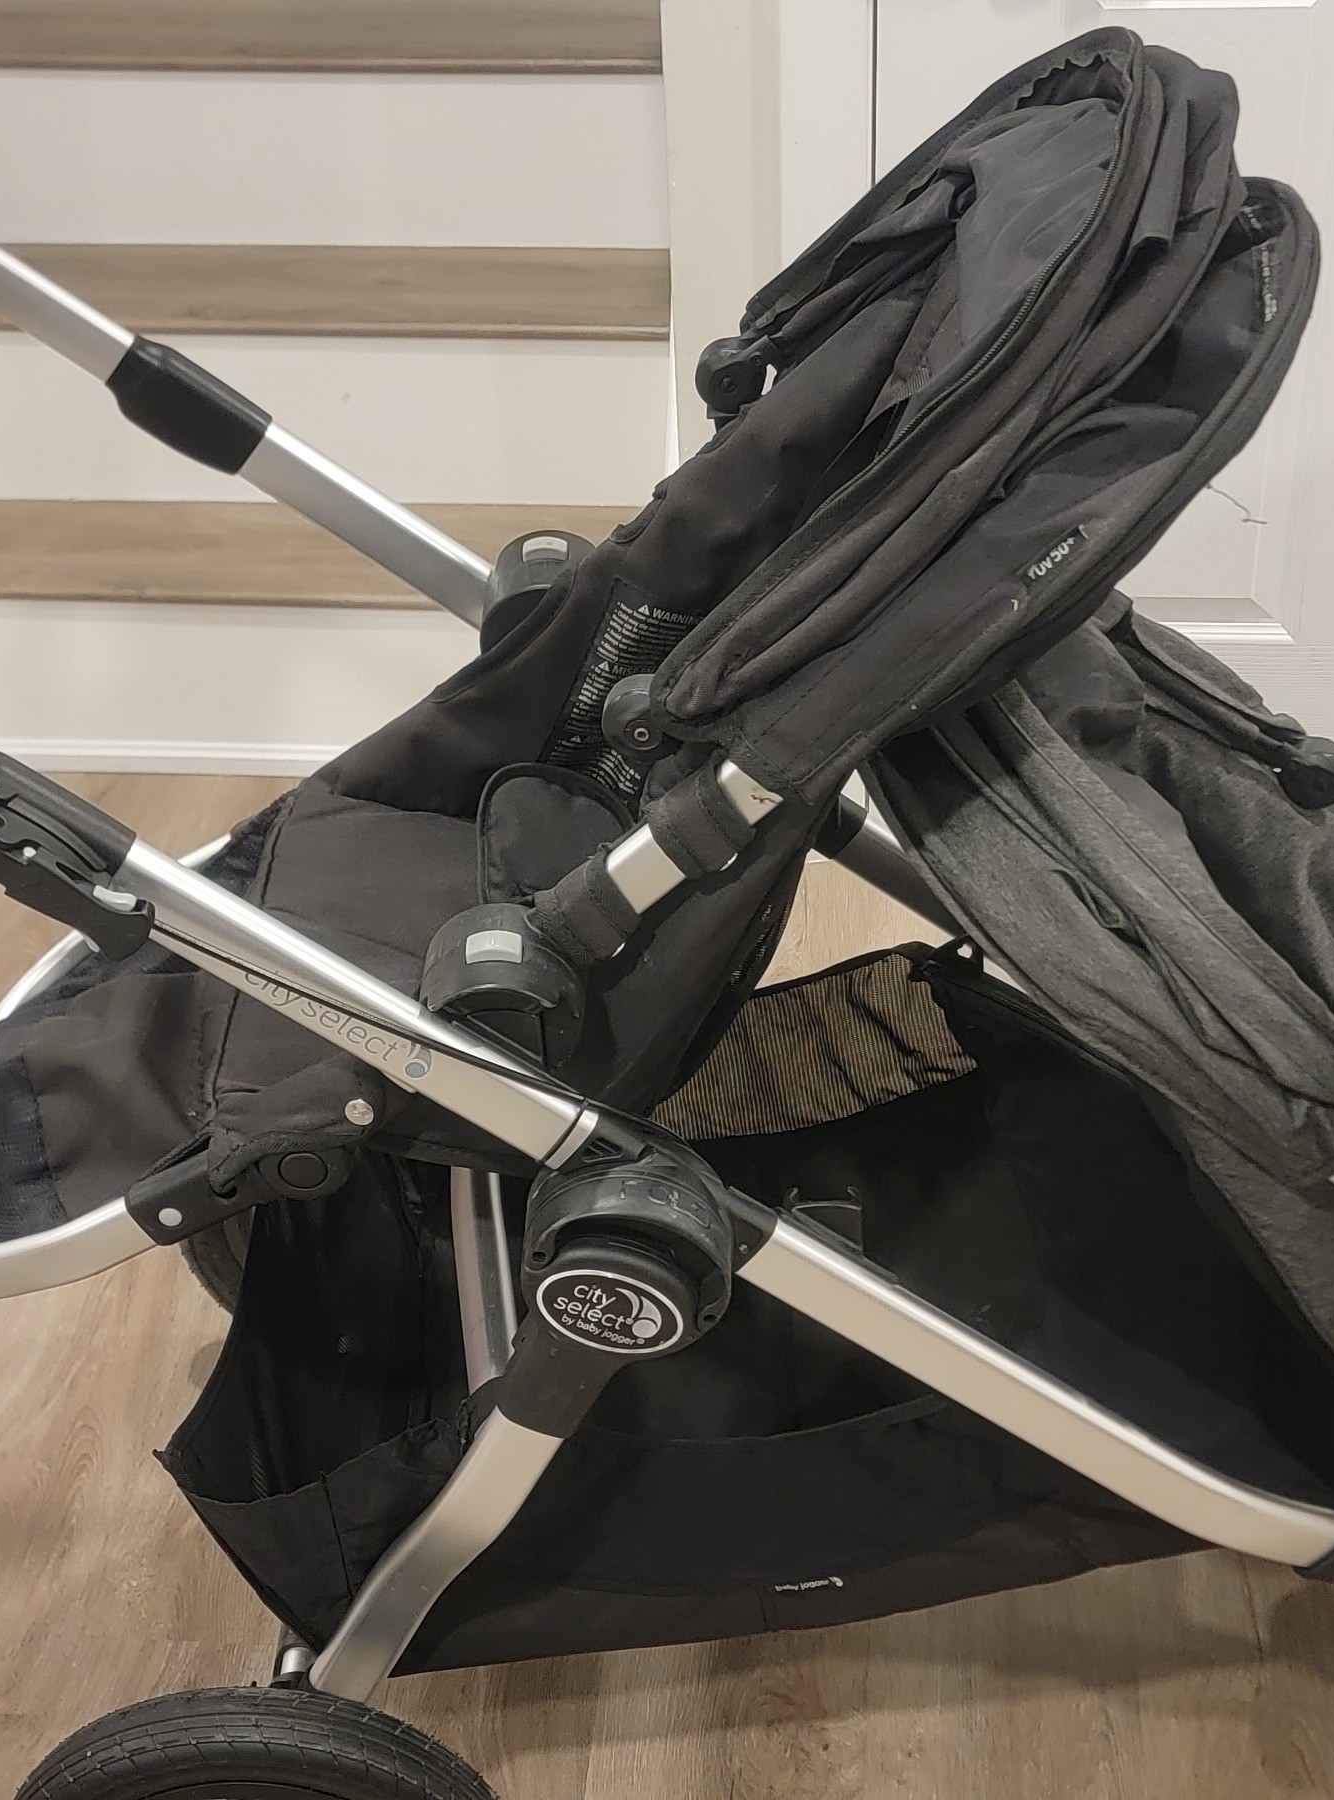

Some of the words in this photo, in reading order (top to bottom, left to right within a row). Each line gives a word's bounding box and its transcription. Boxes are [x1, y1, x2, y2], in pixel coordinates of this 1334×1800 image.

[652, 607, 704, 626] WARNIN
[300, 1001, 398, 1062] select
[553, 1296, 625, 1330] select
[573, 1284, 617, 1309] city
[561, 1313, 575, 1326] by
[576, 1318, 602, 1335] baby
[600, 1329, 636, 1346] jogger
